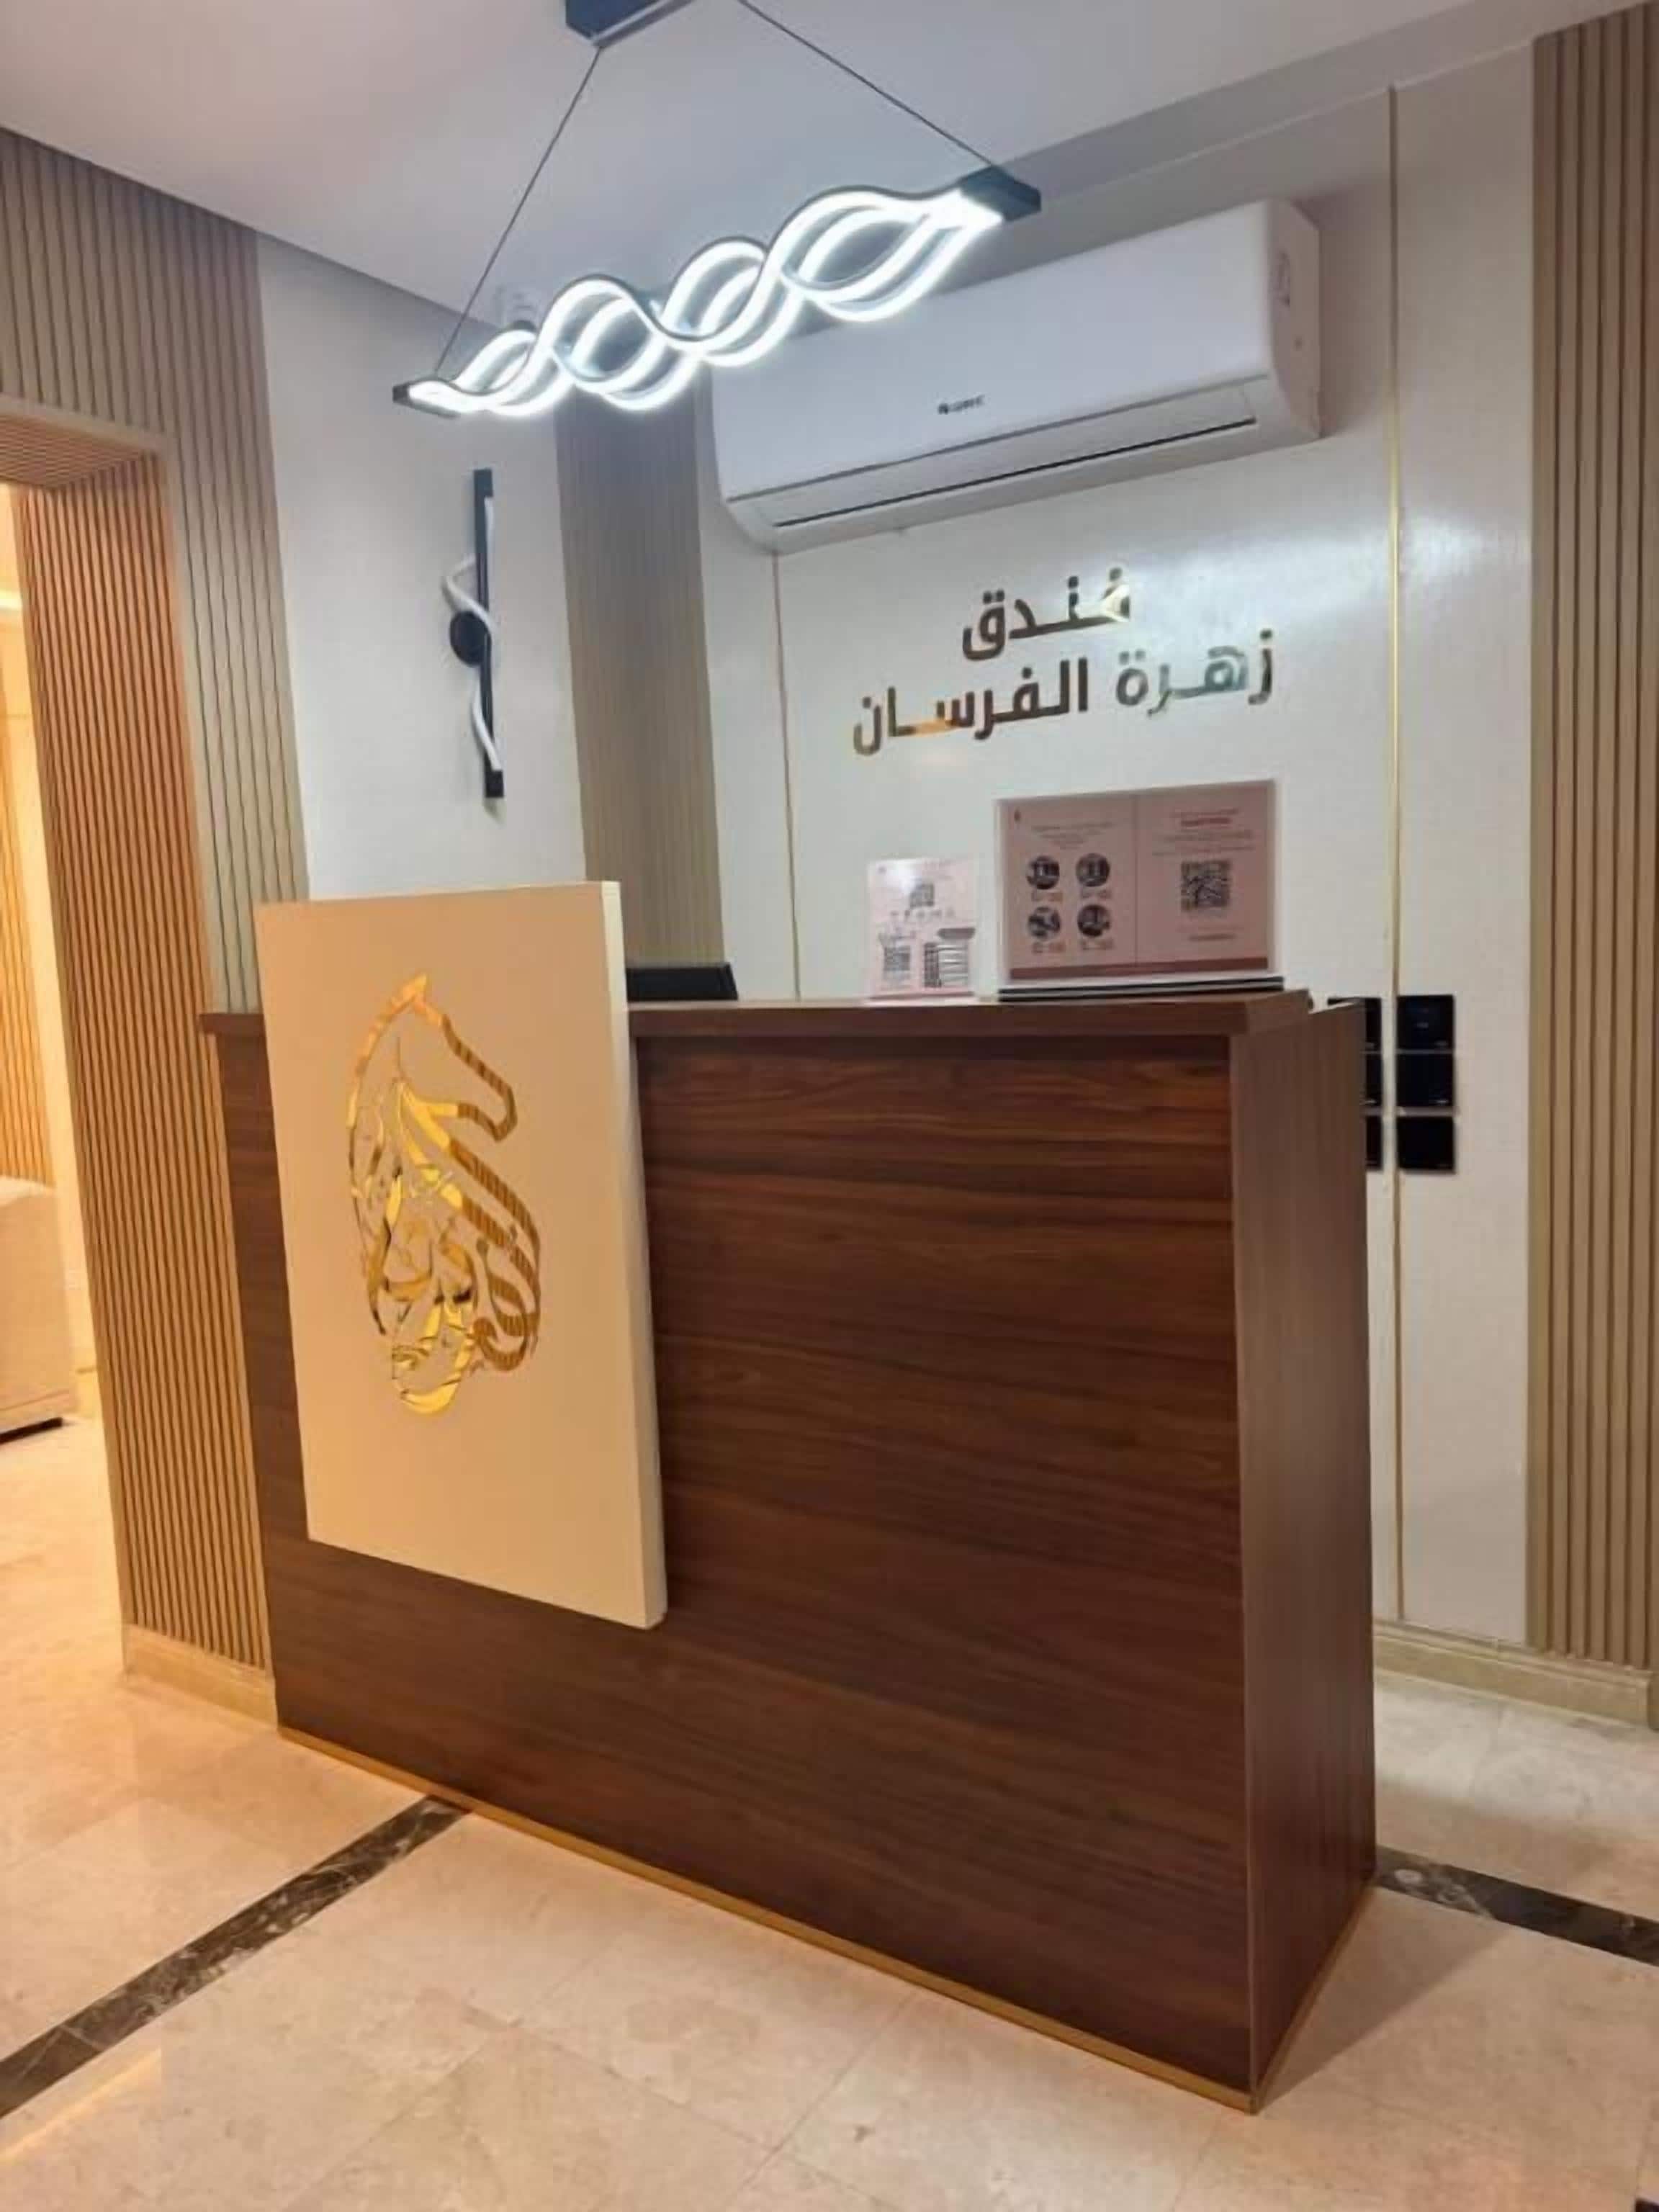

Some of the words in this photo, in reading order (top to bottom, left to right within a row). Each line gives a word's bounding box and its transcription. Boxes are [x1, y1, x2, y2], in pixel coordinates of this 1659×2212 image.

[962, 567, 1131, 660] فندق
[853, 657, 1089, 756] الفرسان
[1115, 629, 1274, 716] زهرة
